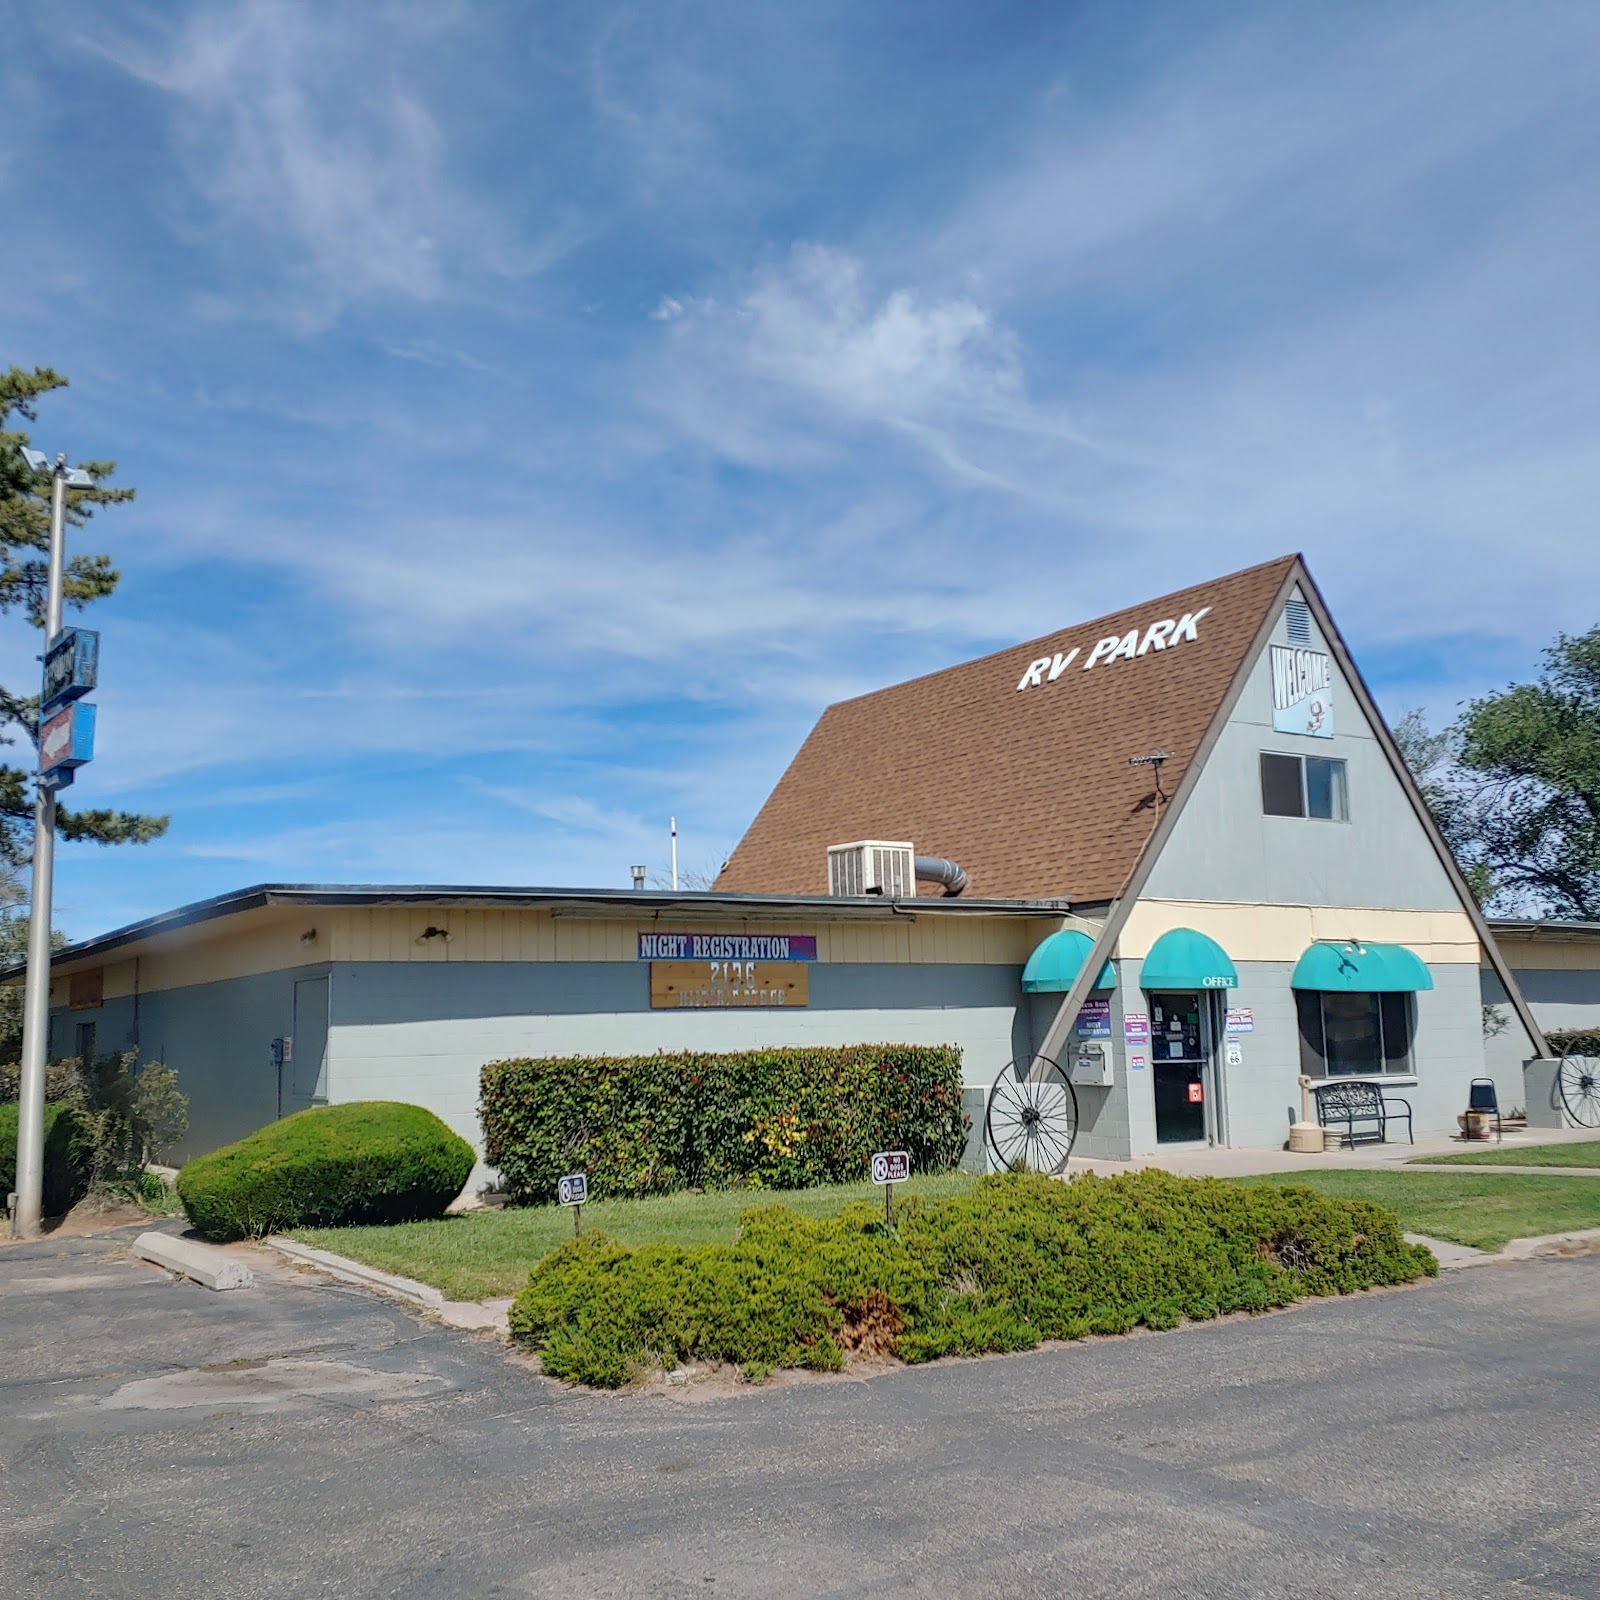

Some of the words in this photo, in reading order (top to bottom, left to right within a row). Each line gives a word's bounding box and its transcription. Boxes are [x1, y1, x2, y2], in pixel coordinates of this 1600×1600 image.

[1016, 647, 1081, 692] RV
[1082, 606, 1214, 672] PARK
[1271, 646, 1330, 710] WELCOME
[640, 934, 687, 958] NIGHT
[692, 936, 790, 959] REGISTRATION
[1202, 976, 1235, 987] OFFICE
